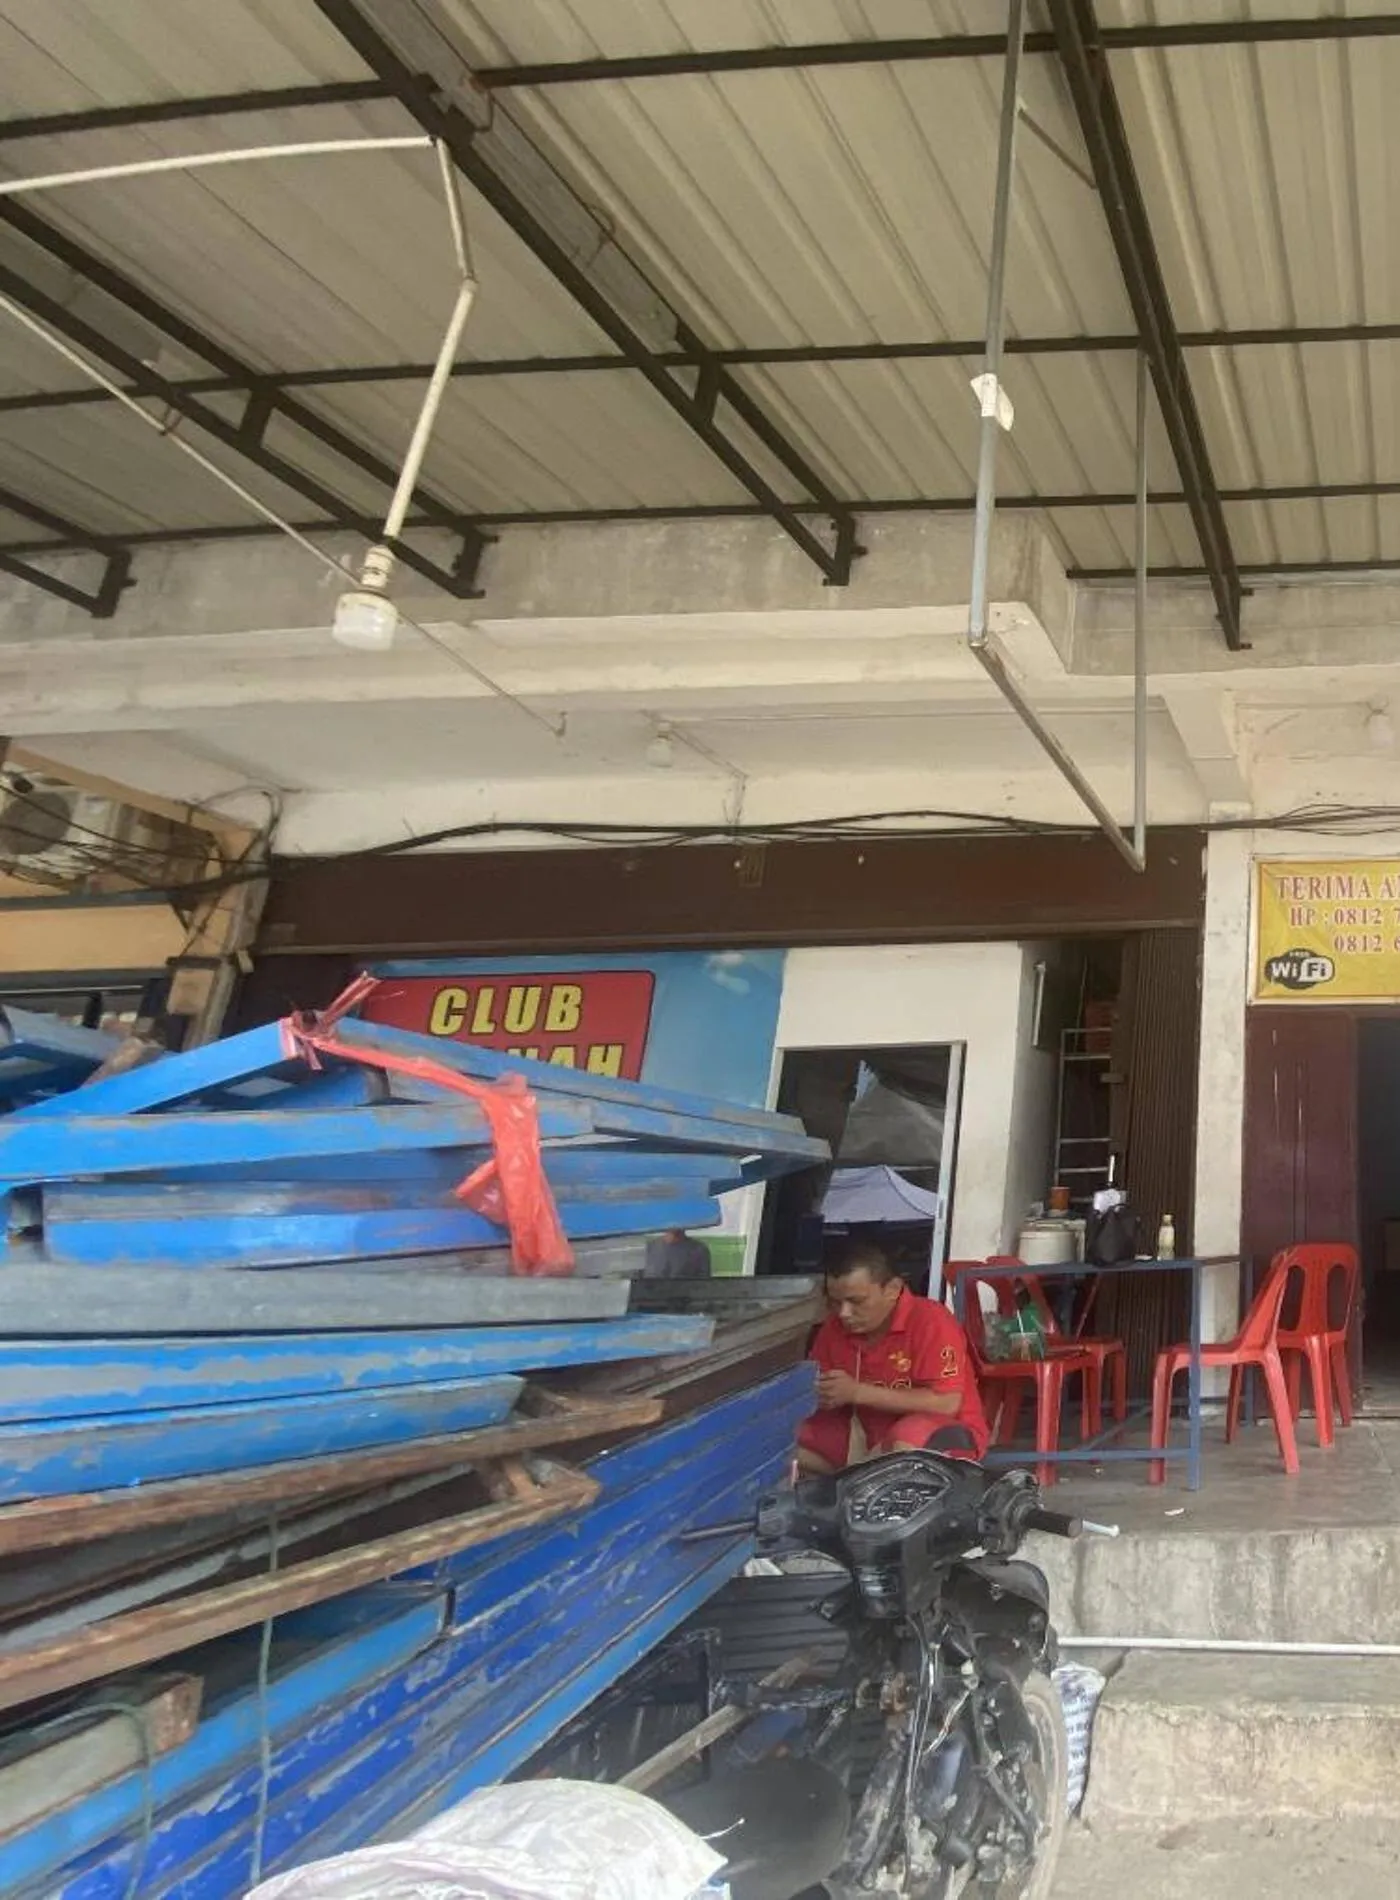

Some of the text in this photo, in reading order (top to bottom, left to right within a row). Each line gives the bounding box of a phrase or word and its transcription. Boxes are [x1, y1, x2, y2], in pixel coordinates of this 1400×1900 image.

[1274, 875, 1373, 900] TERIMA
[1334, 907, 1382, 925] 0812
[1334, 933, 1382, 952] 0812
[428, 984, 584, 1036] CLUB
[939, 1345, 959, 1378] 2
